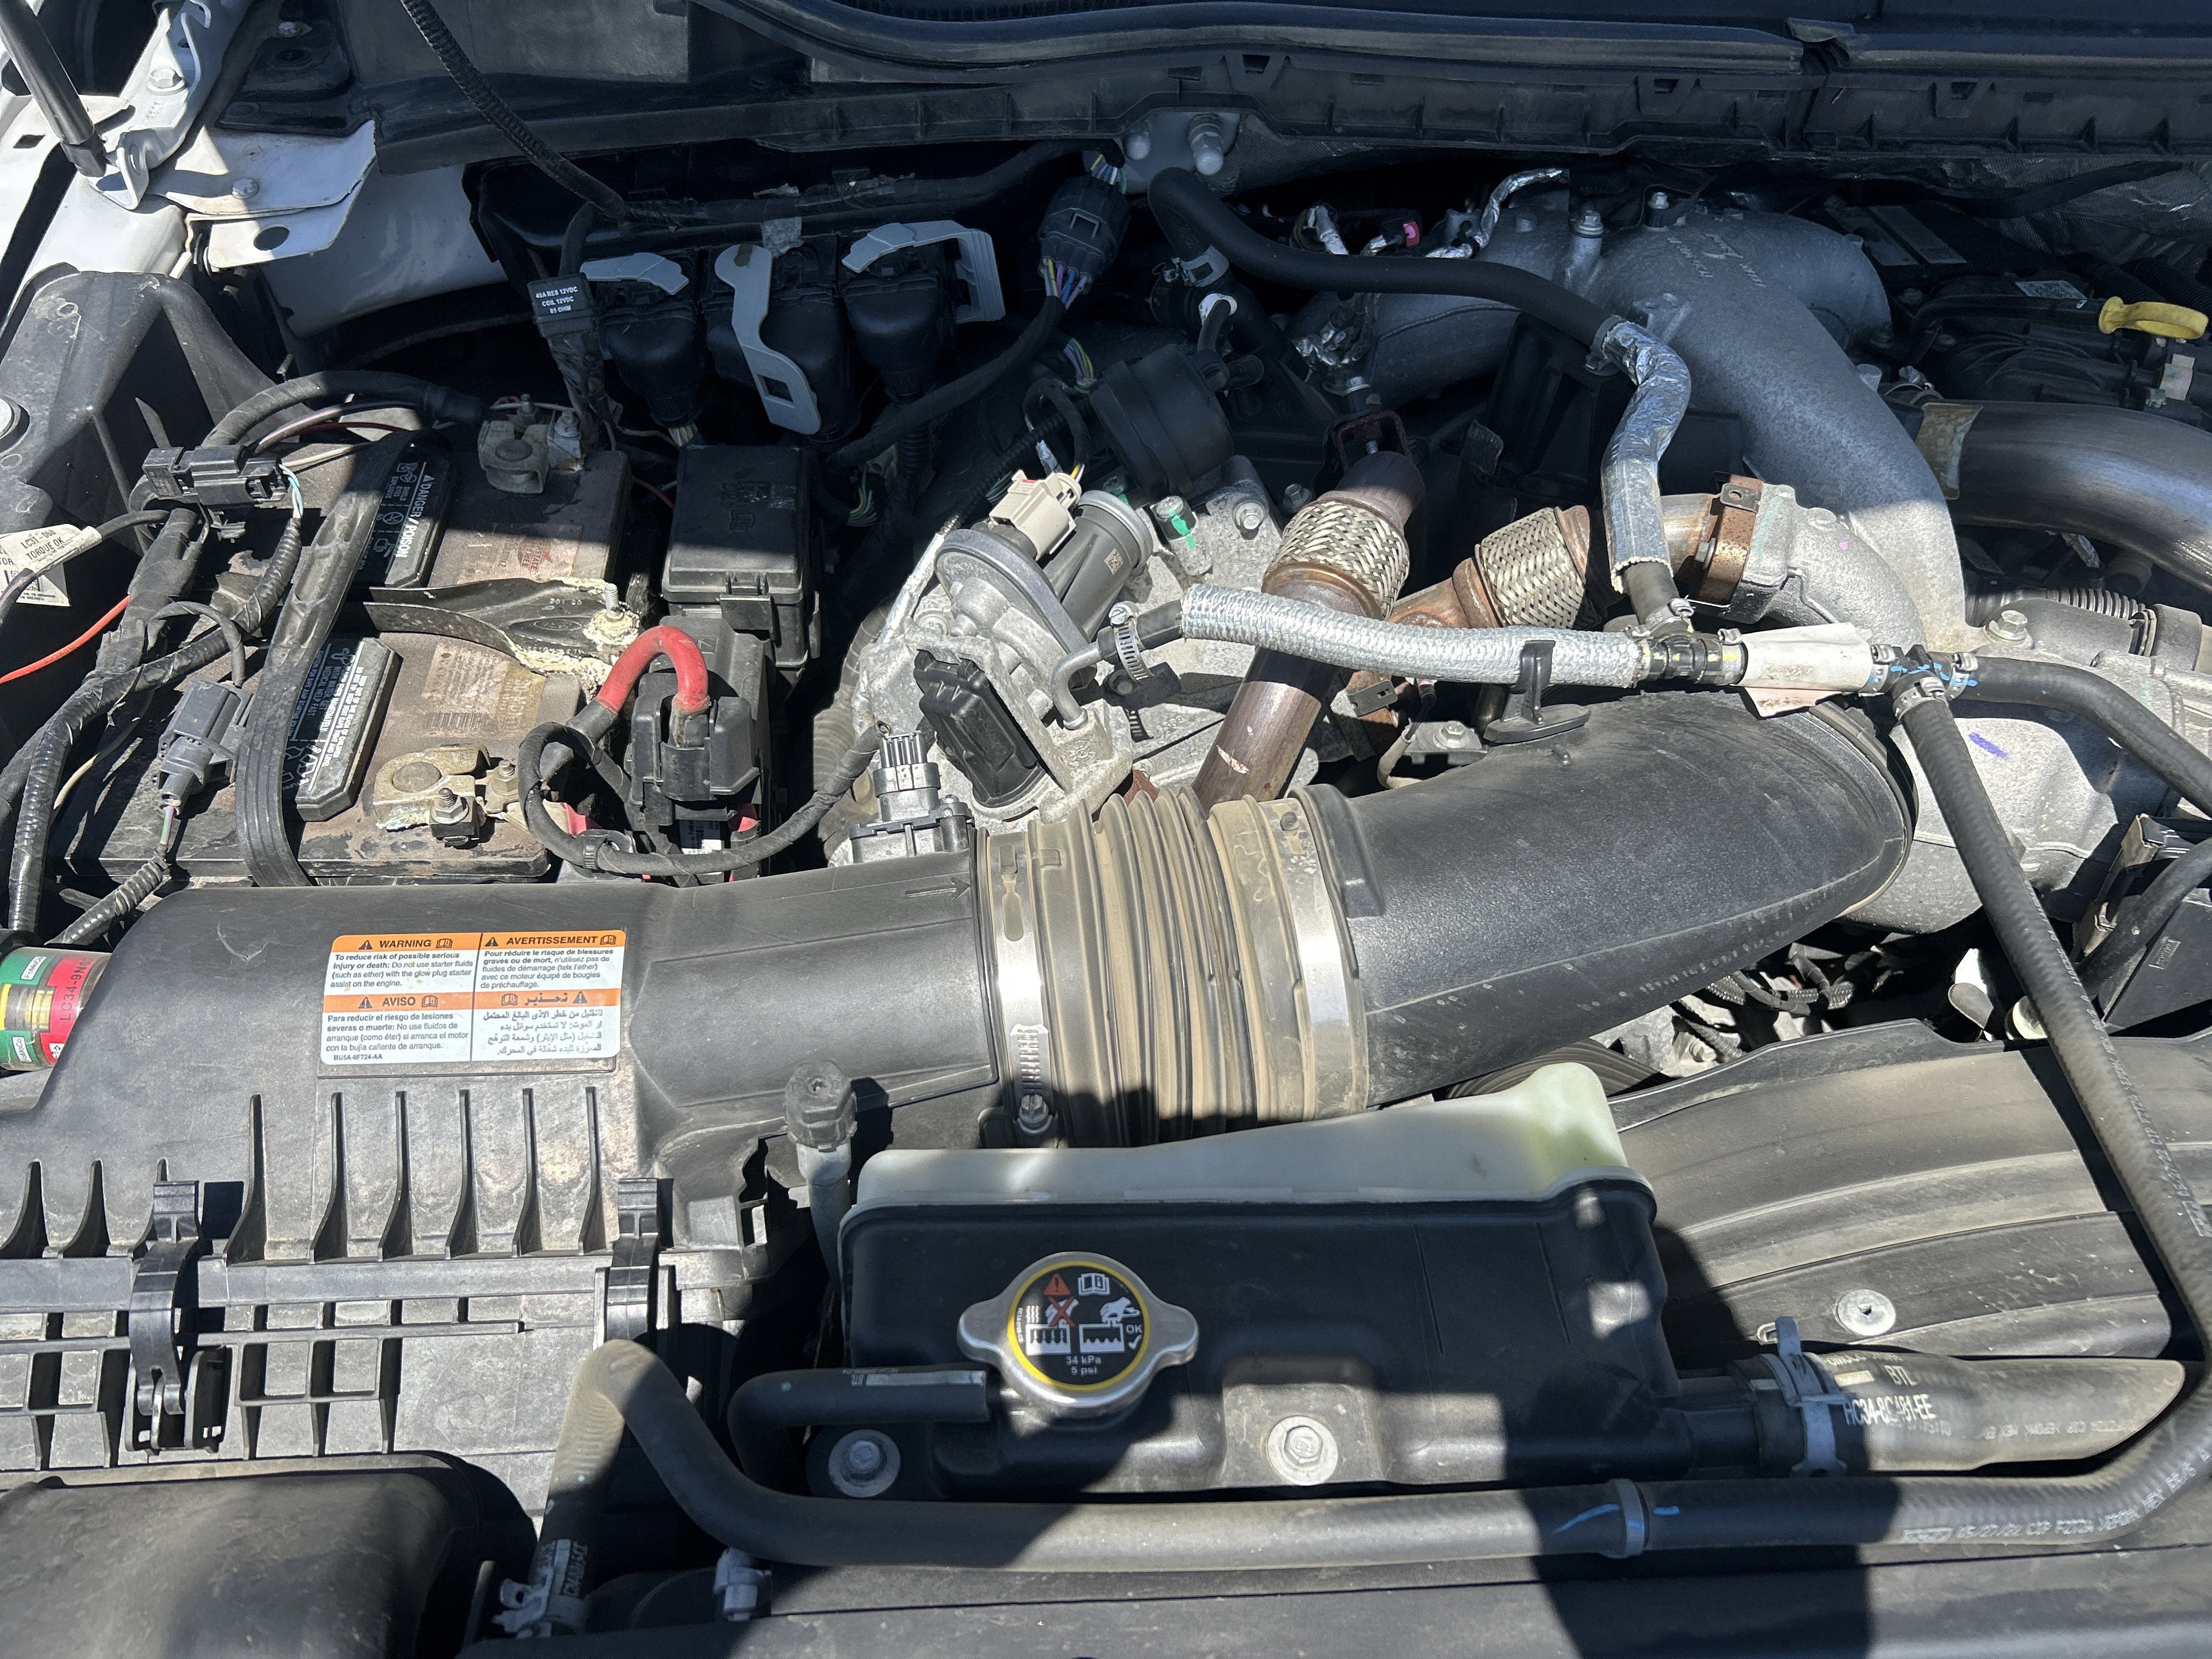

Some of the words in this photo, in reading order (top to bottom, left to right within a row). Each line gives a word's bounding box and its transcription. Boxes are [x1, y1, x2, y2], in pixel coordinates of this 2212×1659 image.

[26, 542, 54, 560] TORQUE
[54, 537, 64, 547] OK
[380, 940, 431, 948] WARNING
[506, 936, 598, 945] AVERTISSEMENT
[398, 952, 430, 961] possible
[517, 964, 556, 973] démarrage
[537, 972, 560, 980] équipé
[376, 980, 402, 988] engine.
[382, 997, 415, 1006] AVISO
[1126, 1324, 1143, 1334] OK
[1066, 1356, 1078, 1364] 34
[1081, 1355, 1101, 1364] kPa
[1071, 1367, 1077, 1375] 5
[1081, 1367, 1097, 1376] psi
[1883, 1364, 1918, 1387] BTL
